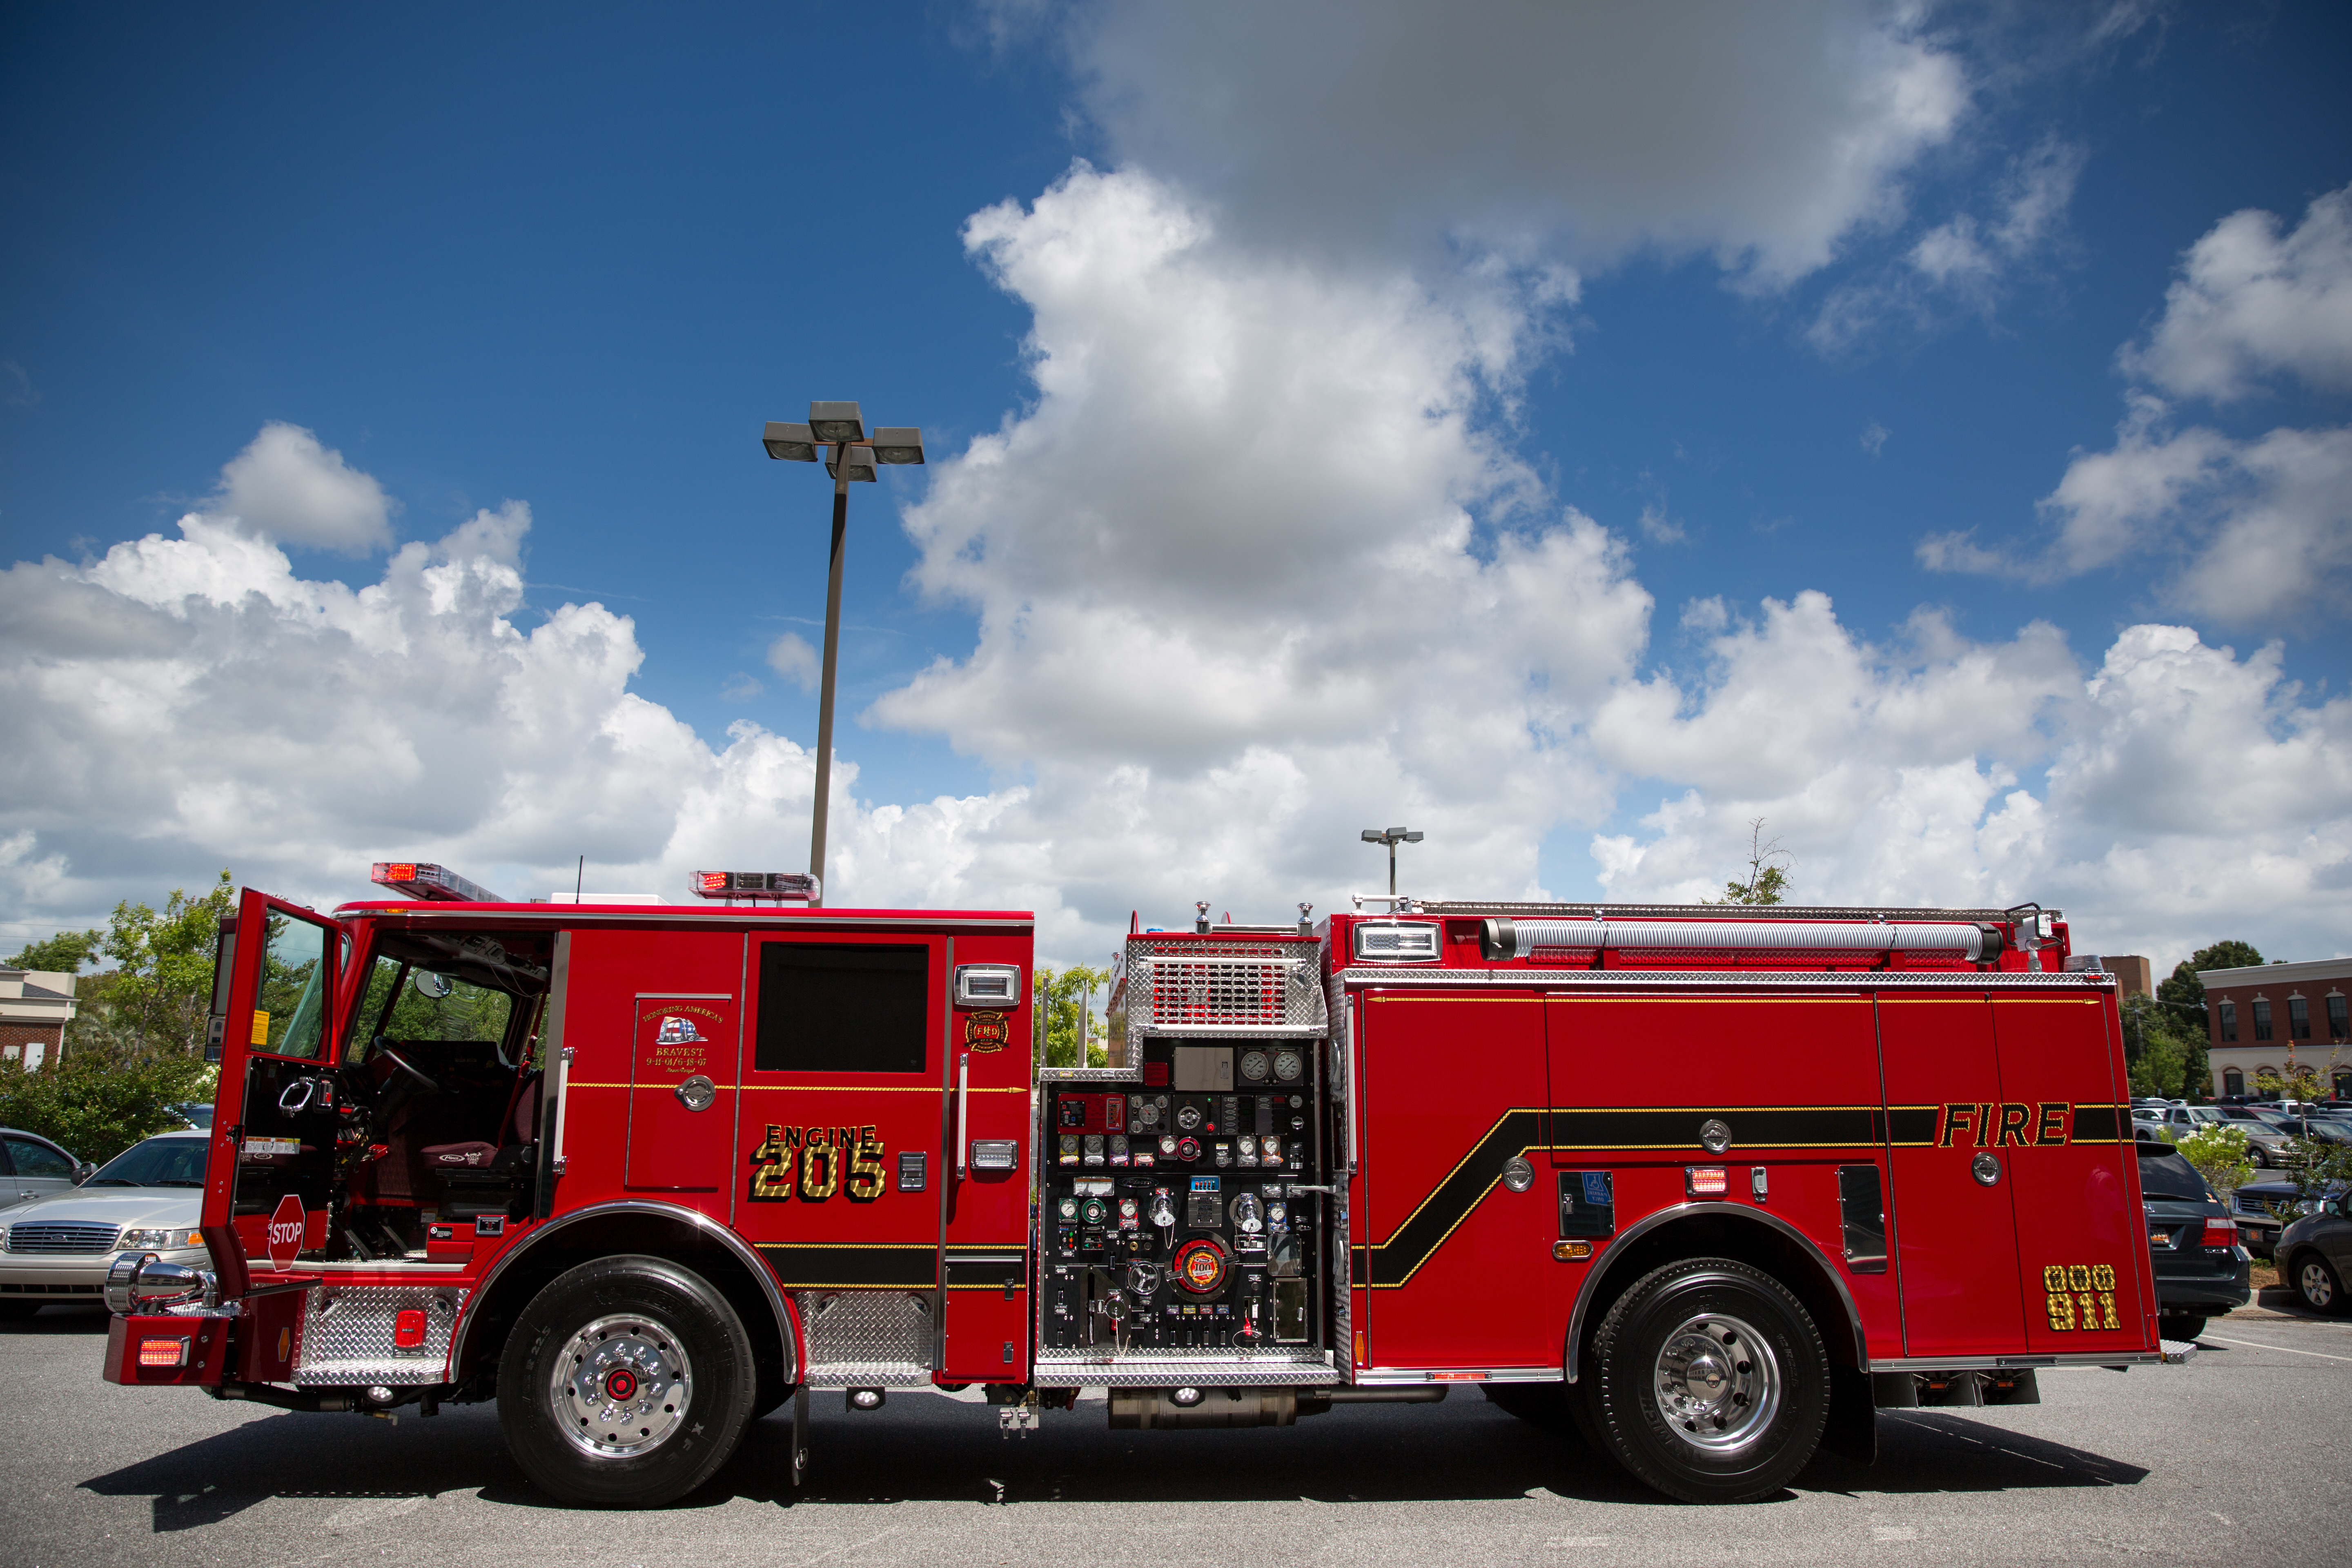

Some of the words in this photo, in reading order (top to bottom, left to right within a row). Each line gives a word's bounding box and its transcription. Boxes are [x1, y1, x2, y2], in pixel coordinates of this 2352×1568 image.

[642, 1006, 683, 1022] HONORING
[684, 1006, 724, 1023] AMERICA'S
[646, 1057, 707, 1066] 9-11-01/6-18-07
[655, 1048, 705, 1056] BRAVEST
[1938, 1102, 2069, 1147] FIRE
[765, 1124, 876, 1151] ENGINE
[747, 1140, 886, 1203] 205
[272, 1222, 302, 1244] STOP
[1194, 1263, 1212, 1272] 100
[2046, 1292, 2120, 1332] 911
